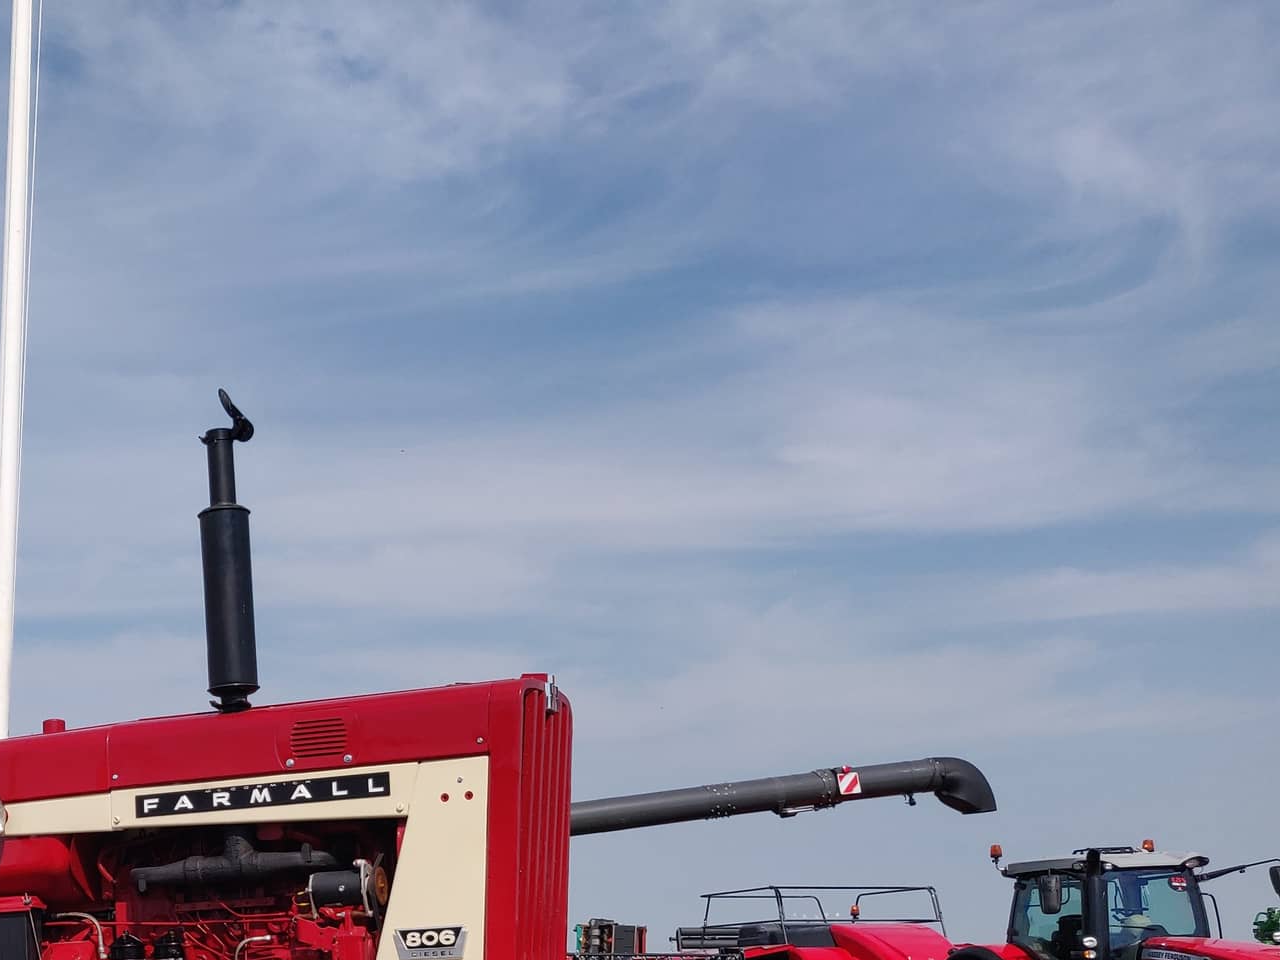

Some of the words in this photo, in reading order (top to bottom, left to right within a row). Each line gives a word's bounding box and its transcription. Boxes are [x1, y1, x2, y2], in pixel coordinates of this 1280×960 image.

[143, 777, 385, 814] FARMALL
[405, 929, 456, 947] 806
[410, 950, 454, 958] DIESEL
